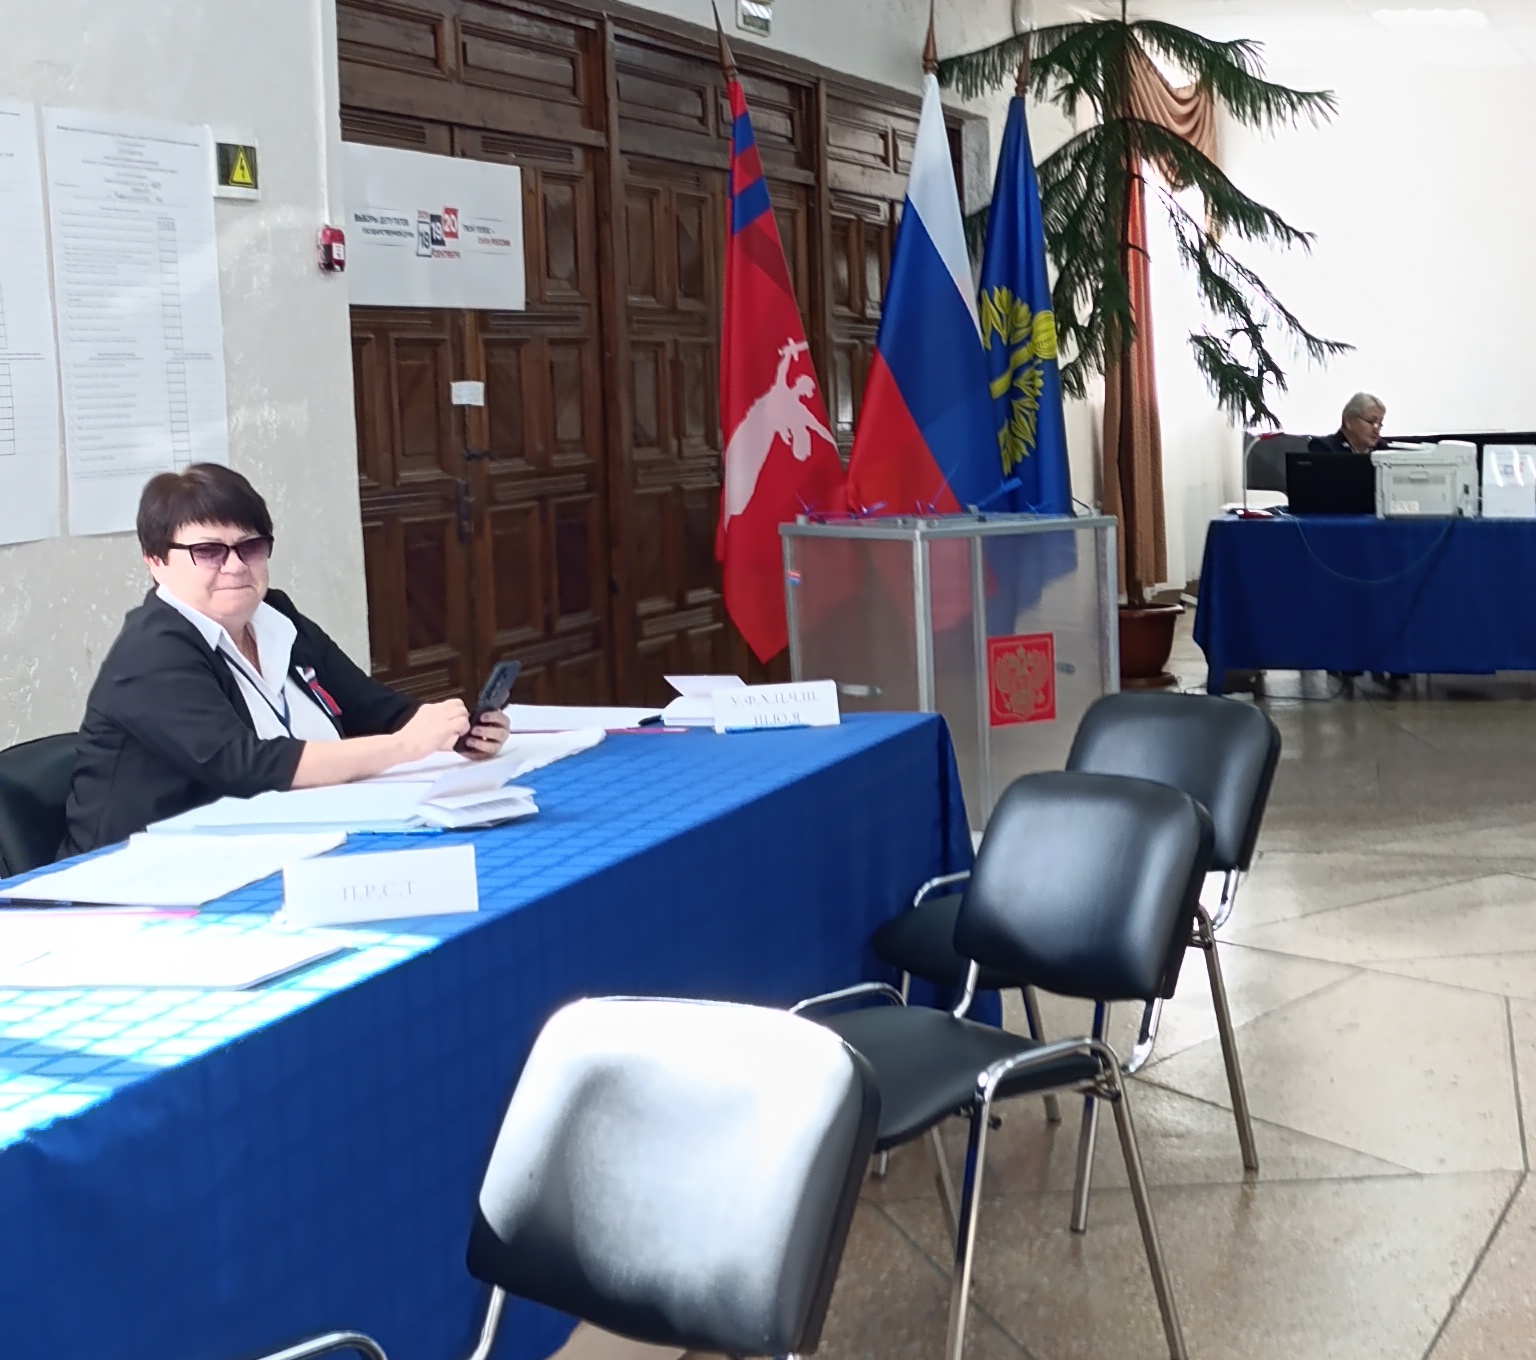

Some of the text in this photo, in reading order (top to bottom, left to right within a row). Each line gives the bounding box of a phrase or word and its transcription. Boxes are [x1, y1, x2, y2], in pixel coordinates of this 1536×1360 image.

[420, 213, 458, 249] 18 19 20
